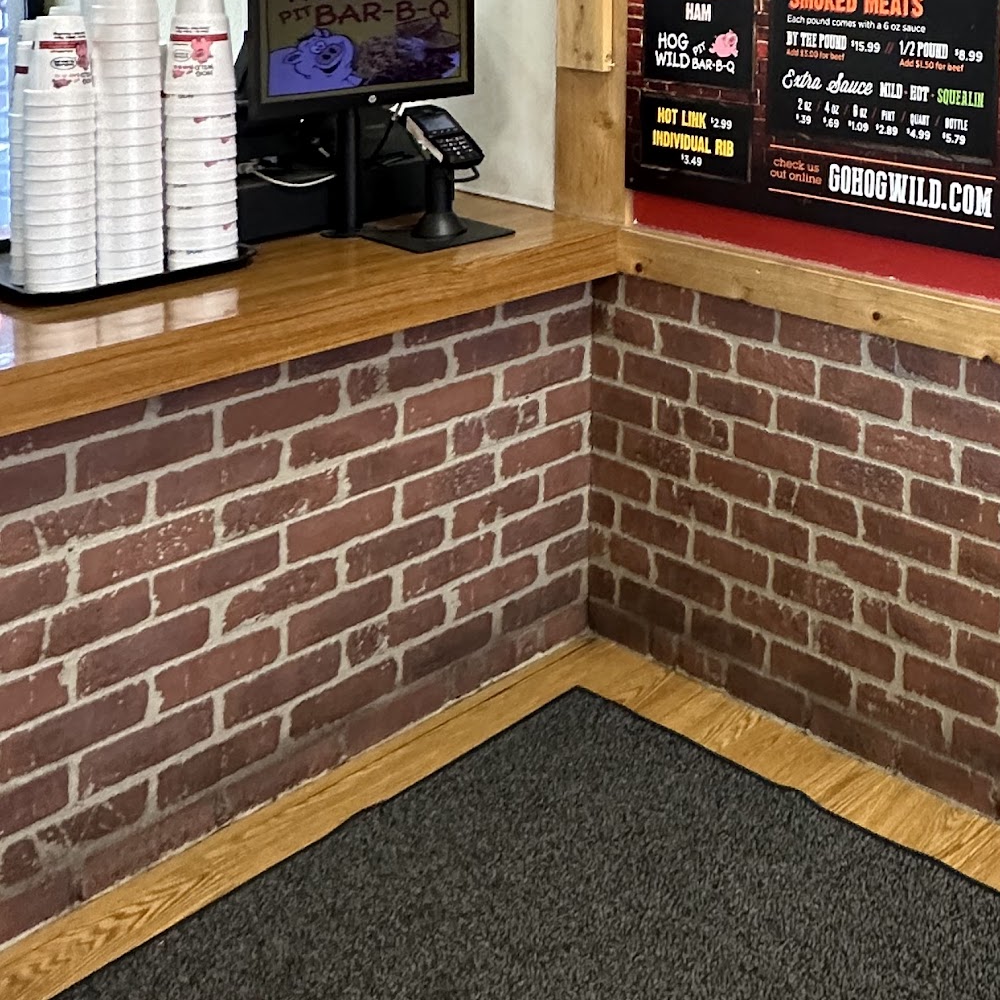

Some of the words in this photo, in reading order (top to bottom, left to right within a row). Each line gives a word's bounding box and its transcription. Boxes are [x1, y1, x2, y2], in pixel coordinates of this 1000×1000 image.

[279, 5, 312, 24] PIT
[315, 0, 450, 27] BAR-B-Q
[685, 2, 711, 22] HAM
[658, 32, 689, 50] HOG
[655, 51, 690, 68] WILD
[782, 69, 822, 91] Extra
[826, 73, 873, 95] Sauce
[657, 107, 677, 124] HOT
[681, 109, 706, 129] LINK
[711, 116, 732, 130] $2.99
[828, 164, 992, 218] GOHOGWILD.COM
